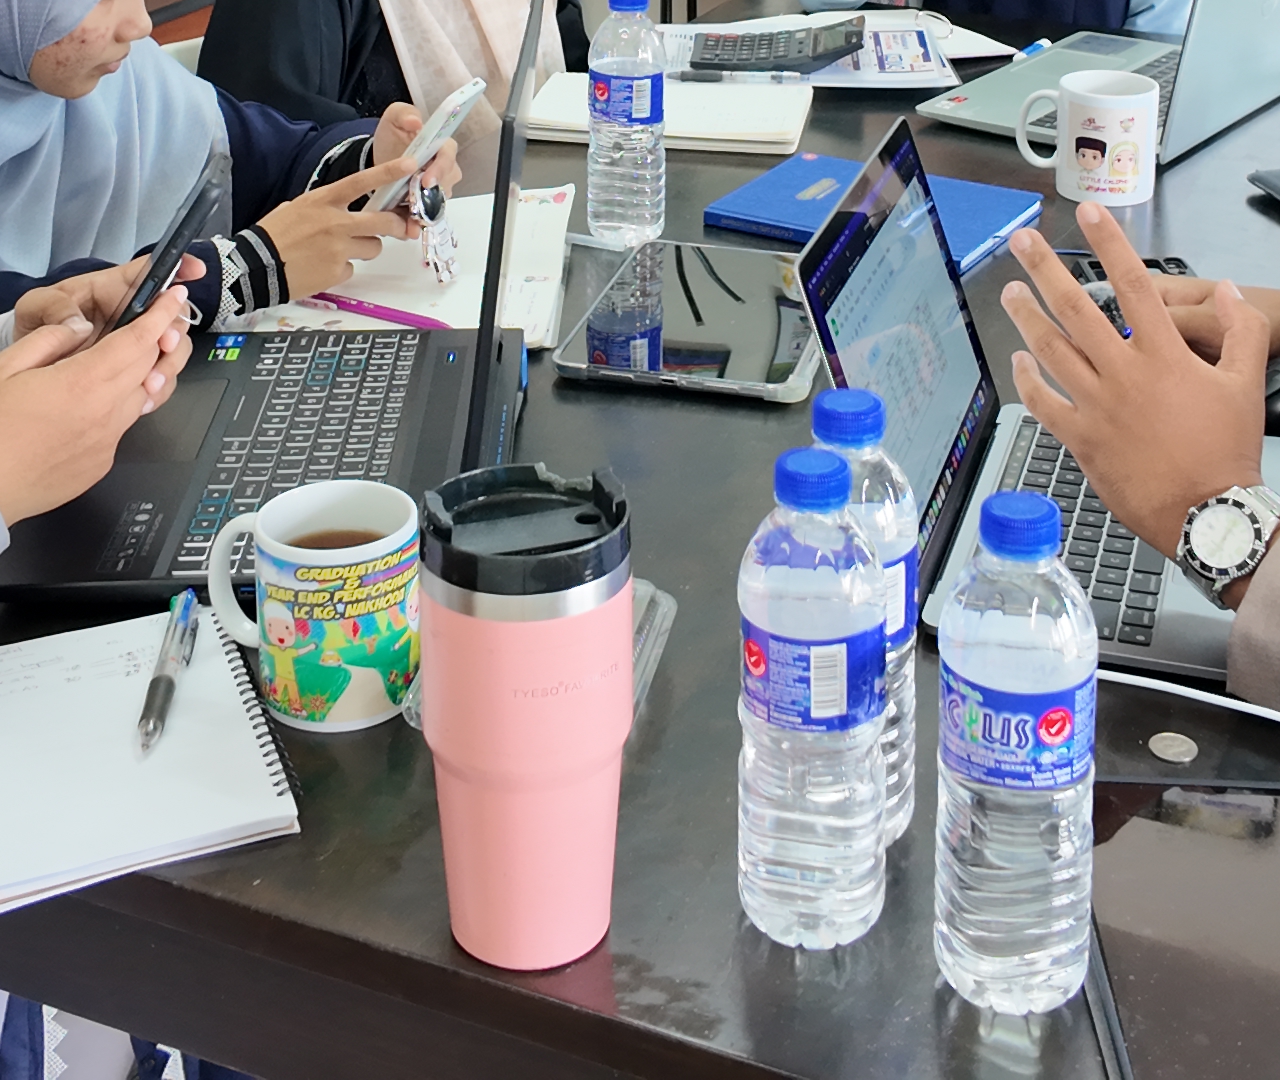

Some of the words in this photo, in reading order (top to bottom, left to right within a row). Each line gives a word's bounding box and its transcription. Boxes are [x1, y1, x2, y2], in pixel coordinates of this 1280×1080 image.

[1080, 176, 1100, 184] LITTLE
[295, 551, 403, 581] GRADUATION
[266, 584, 295, 602] YEAR
[297, 590, 331, 605] END
[333, 562, 419, 604] PERFORMANC
[344, 577, 360, 591] &
[293, 605, 310, 619] LC
[313, 605, 340, 620] KG.
[344, 587, 406, 619] NAKHODA
[512, 686, 559, 698] TYESO
[564, 661, 619, 694] FAVRITE
